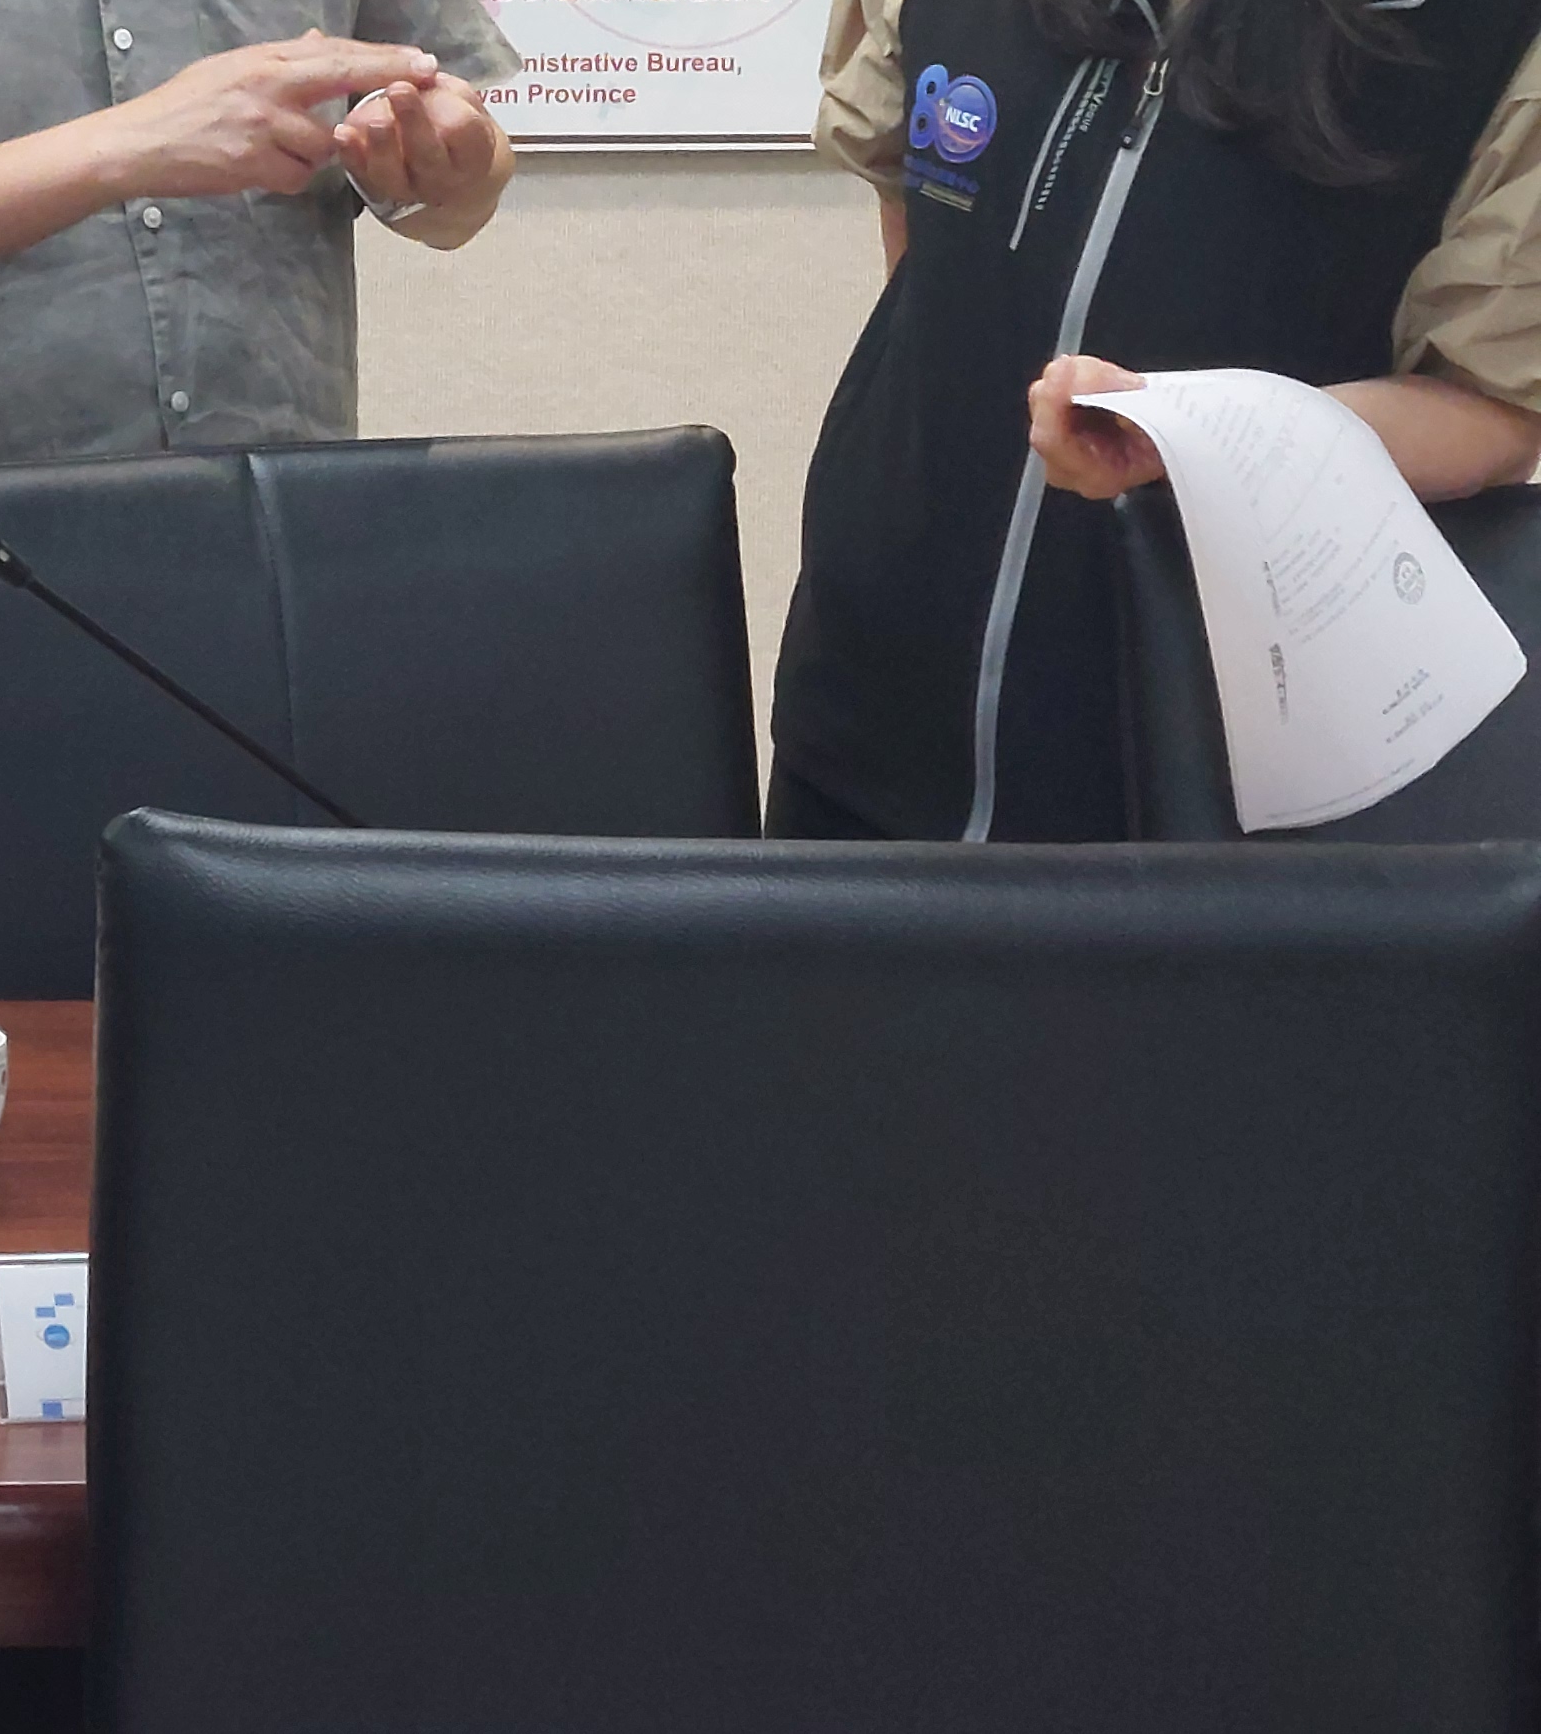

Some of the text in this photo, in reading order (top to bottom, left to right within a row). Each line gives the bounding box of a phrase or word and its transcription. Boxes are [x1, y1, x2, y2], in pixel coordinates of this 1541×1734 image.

[520, 52, 742, 76] nistrative Bureau,
[528, 83, 636, 104] Province
[945, 107, 982, 133] NLSC
